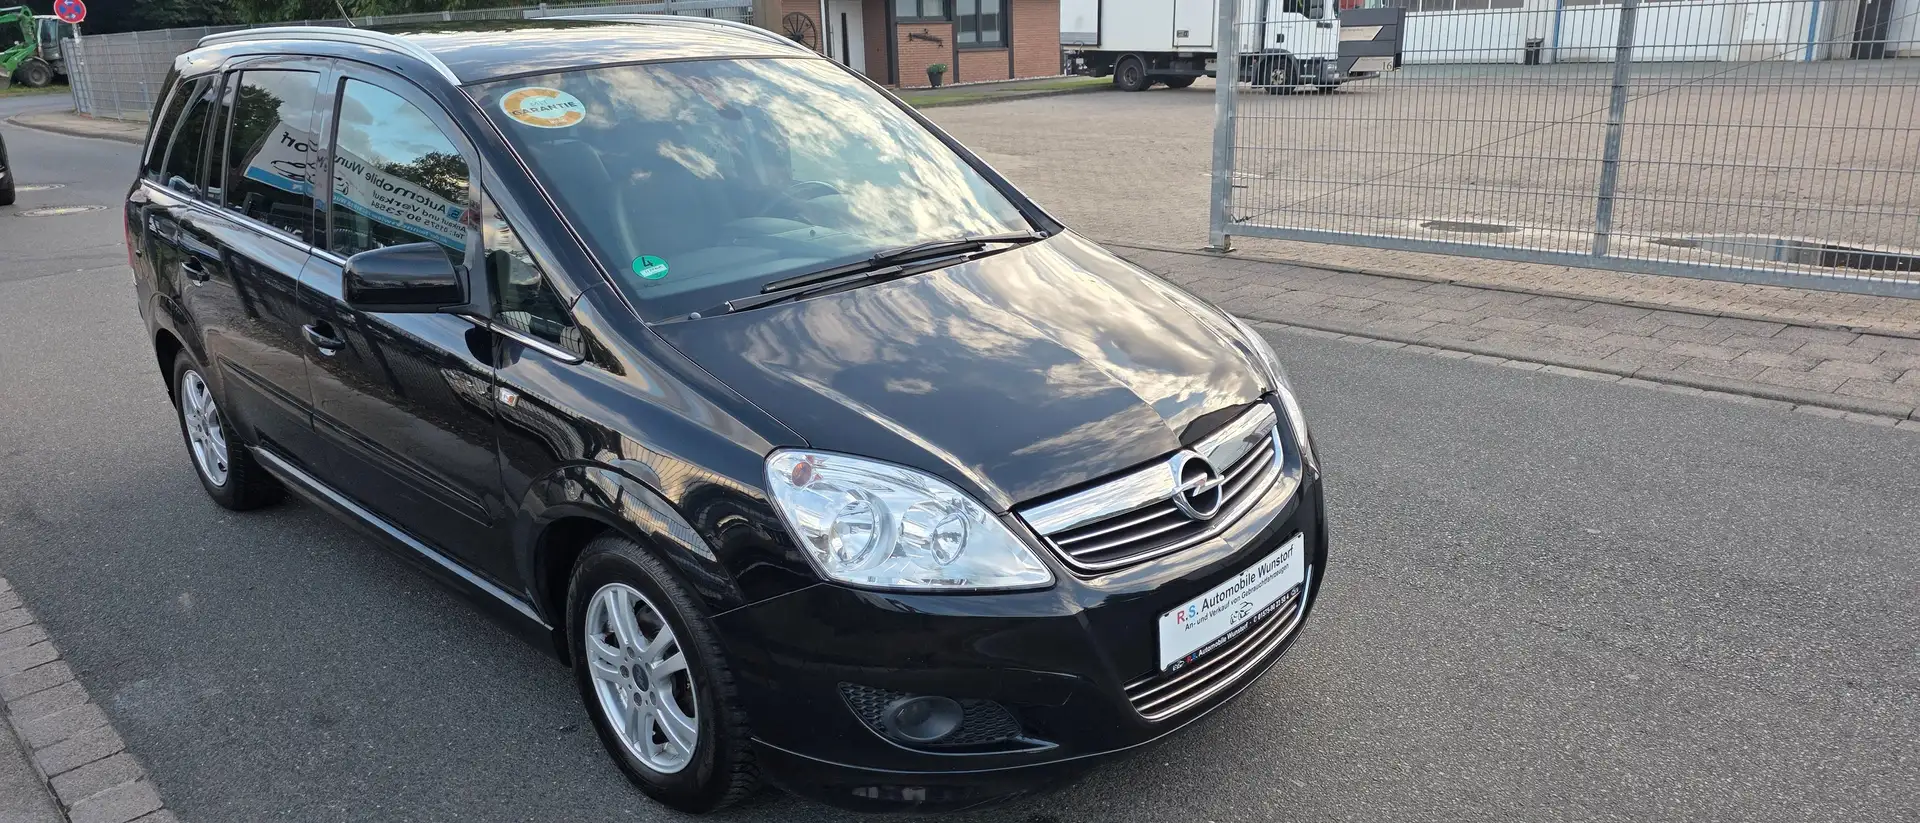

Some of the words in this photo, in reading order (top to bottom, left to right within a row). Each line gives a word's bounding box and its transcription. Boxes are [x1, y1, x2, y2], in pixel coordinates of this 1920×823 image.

[1382, 61, 1392, 70] 16
[511, 101, 578, 116] GARANTIE
[641, 256, 654, 267] 4
[1176, 605, 1199, 625] R.S.
[1201, 572, 1256, 612] Automobile
[1257, 544, 1294, 577] Wunstorf
[1184, 621, 1197, 632] An-
[1197, 613, 1209, 625] und
[1209, 602, 1230, 618] Verkauf
[1230, 595, 1241, 605] von
[1198, 637, 1227, 657] Automobile
[1226, 623, 1249, 643] Wunstorf
